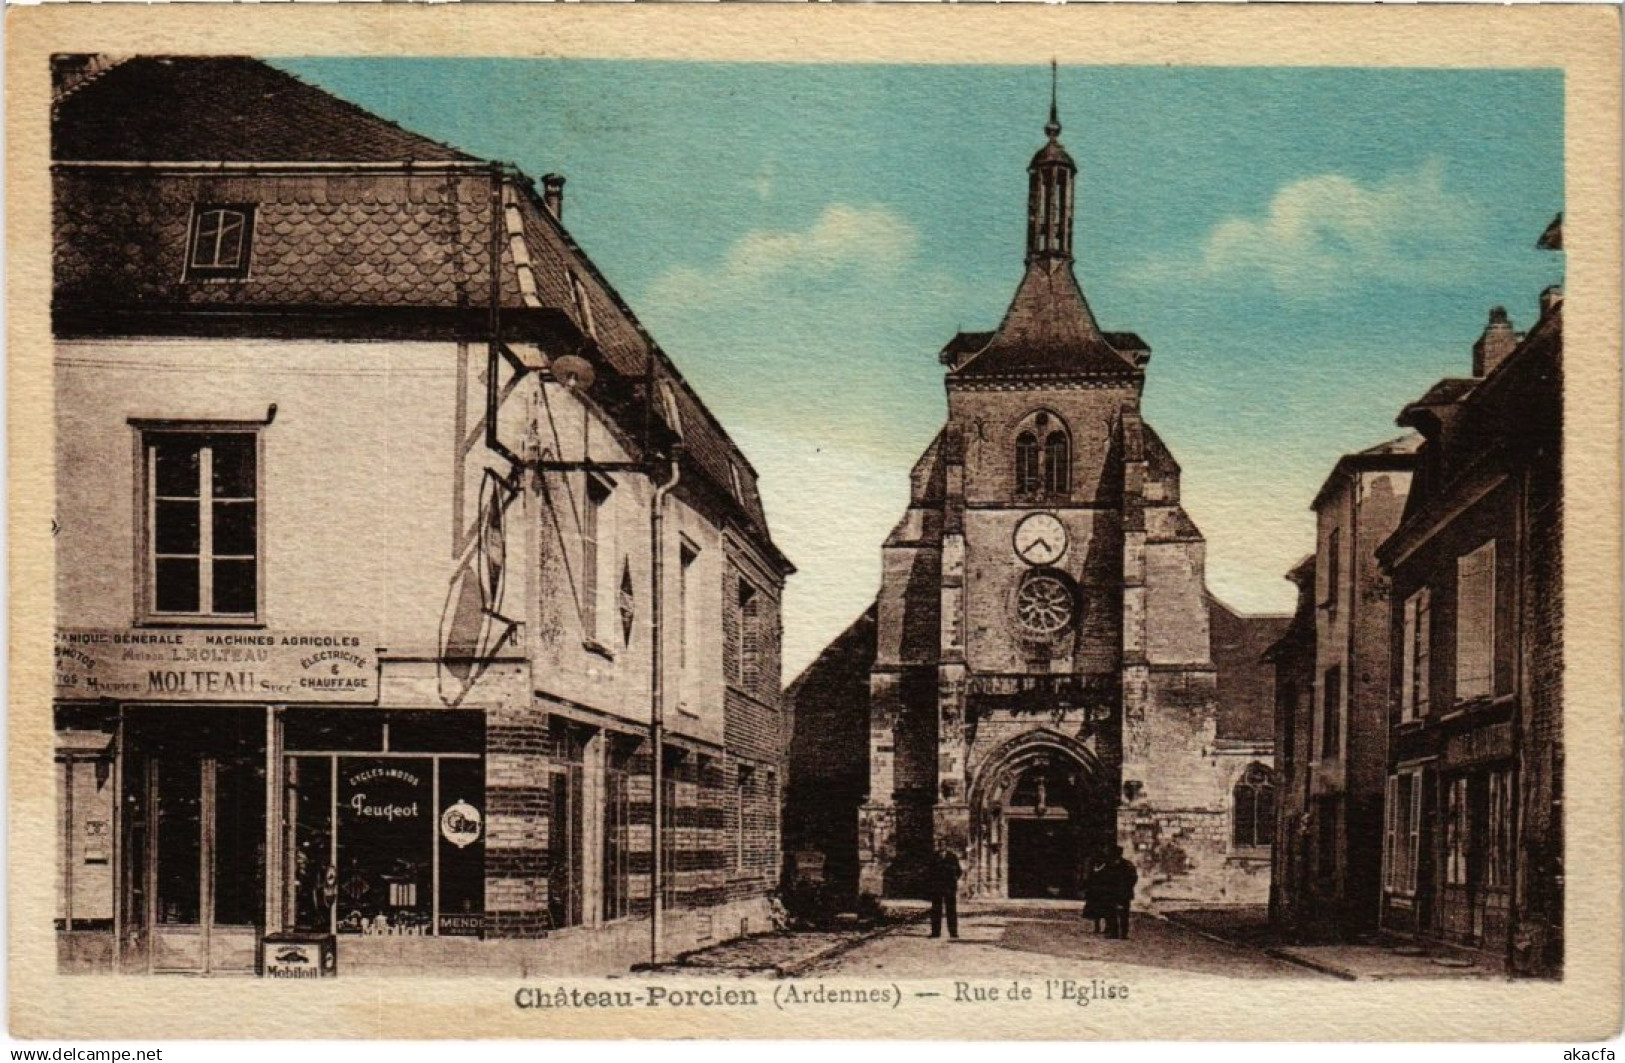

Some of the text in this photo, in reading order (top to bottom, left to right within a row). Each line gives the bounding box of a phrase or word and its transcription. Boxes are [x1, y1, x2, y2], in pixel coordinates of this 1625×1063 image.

[205, 635, 275, 646] MACHINES
[281, 636, 360, 647] AGRICOLES
[301, 650, 367, 670] ÉLECTRICITÉ
[331, 664, 340, 675] &
[148, 671, 255, 694] MOLTEAU
[300, 678, 369, 688] CHAUFFAGE
[350, 768, 384, 786] CYCLES
[351, 793, 419, 821] Peugeot
